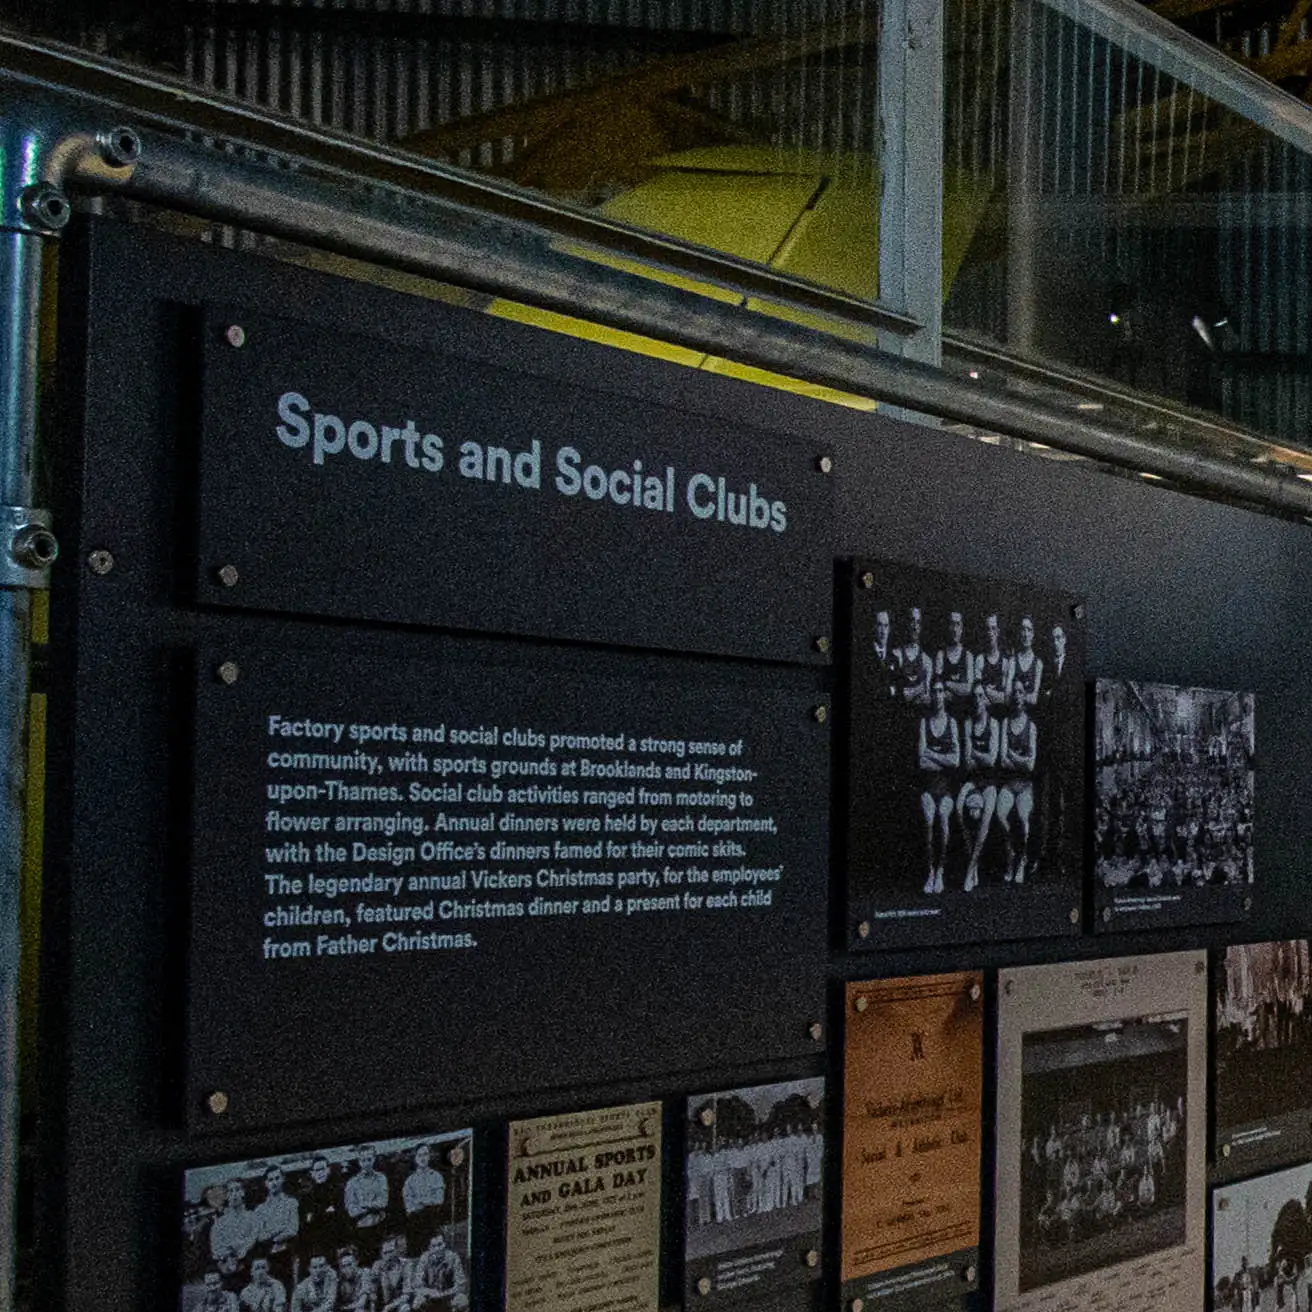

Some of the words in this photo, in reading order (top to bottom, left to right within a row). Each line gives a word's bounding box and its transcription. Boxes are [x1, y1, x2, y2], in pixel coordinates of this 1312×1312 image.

[276, 391, 445, 473] Sports
[459, 439, 541, 489] and
[556, 446, 675, 513] Social
[686, 473, 788, 534] Clubs
[268, 715, 344, 743] Factory
[350, 722, 407, 744] sports
[412, 724, 445, 742] and
[450, 726, 498, 745] social
[503, 728, 545, 747] clubs
[550, 734, 624, 752] promoted
[628, 740, 637, 751] a
[640, 737, 685, 757] strong
[689, 742, 726, 755] sense
[728, 739, 743, 756] of
[267, 750, 383, 775] community,
[388, 752, 428, 772] with
[433, 757, 487, 776] sports
[491, 758, 557, 778] grounds
[561, 761, 576, 776] at
[580, 759, 661, 779] Brooklands
[665, 763, 690, 780] and
[695, 763, 758, 785] Kingston-
[267, 780, 403, 804] upon-Thames.
[409, 782, 462, 802] Social
[467, 784, 503, 803] club
[508, 785, 579, 804] activities
[583, 786, 635, 809] ranged
[638, 788, 672, 805] from
[676, 790, 736, 810] motoring
[739, 792, 754, 807] to
[265, 811, 330, 832] flower
[335, 812, 428, 836] arranging.
[435, 812, 495, 832] Annual
[500, 813, 558, 832] dinners
[562, 819, 601, 832] were
[604, 814, 636, 832] held
[640, 815, 657, 836] by
[661, 815, 694, 832] each
[698, 815, 778, 836] department,
[265, 842, 310, 863] with
[315, 843, 347, 862] the
[352, 842, 415, 866] Design
[420, 841, 486, 862] Office's
[490, 841, 550, 860] dinners
[554, 841, 602, 859] famed
[607, 840, 628, 858] for
[631, 840, 664, 858] their
[668, 841, 709, 858] comic
[712, 839, 746, 858] skits.
[265, 874, 303, 895] The
[308, 872, 403, 898] legendary
[408, 872, 466, 891] annual
[471, 870, 532, 889] Vickers
[536, 868, 614, 888] Christmas
[617, 869, 661, 889] party,
[663, 866, 683, 884] for
[686, 865, 709, 884] the
[263, 905, 351, 927] children,
[356, 901, 434, 923] featured
[438, 899, 524, 919] Christmas
[528, 896, 578, 916] dinner
[582, 894, 610, 914] and
[614, 900, 623, 912] a
[626, 893, 681, 915] present
[683, 891, 704, 910] for
[706, 890, 738, 908] each
[740, 889, 772, 907] child
[263, 938, 311, 959] from
[316, 934, 378, 956] Father
[381, 930, 478, 951] Christmas.
[513, 1156, 589, 1185] ANNUAL
[594, 1144, 657, 1169] SPORTS
[520, 1190, 552, 1207] AND
[558, 1176, 605, 1198] GALA
[613, 1168, 648, 1188] DAY
